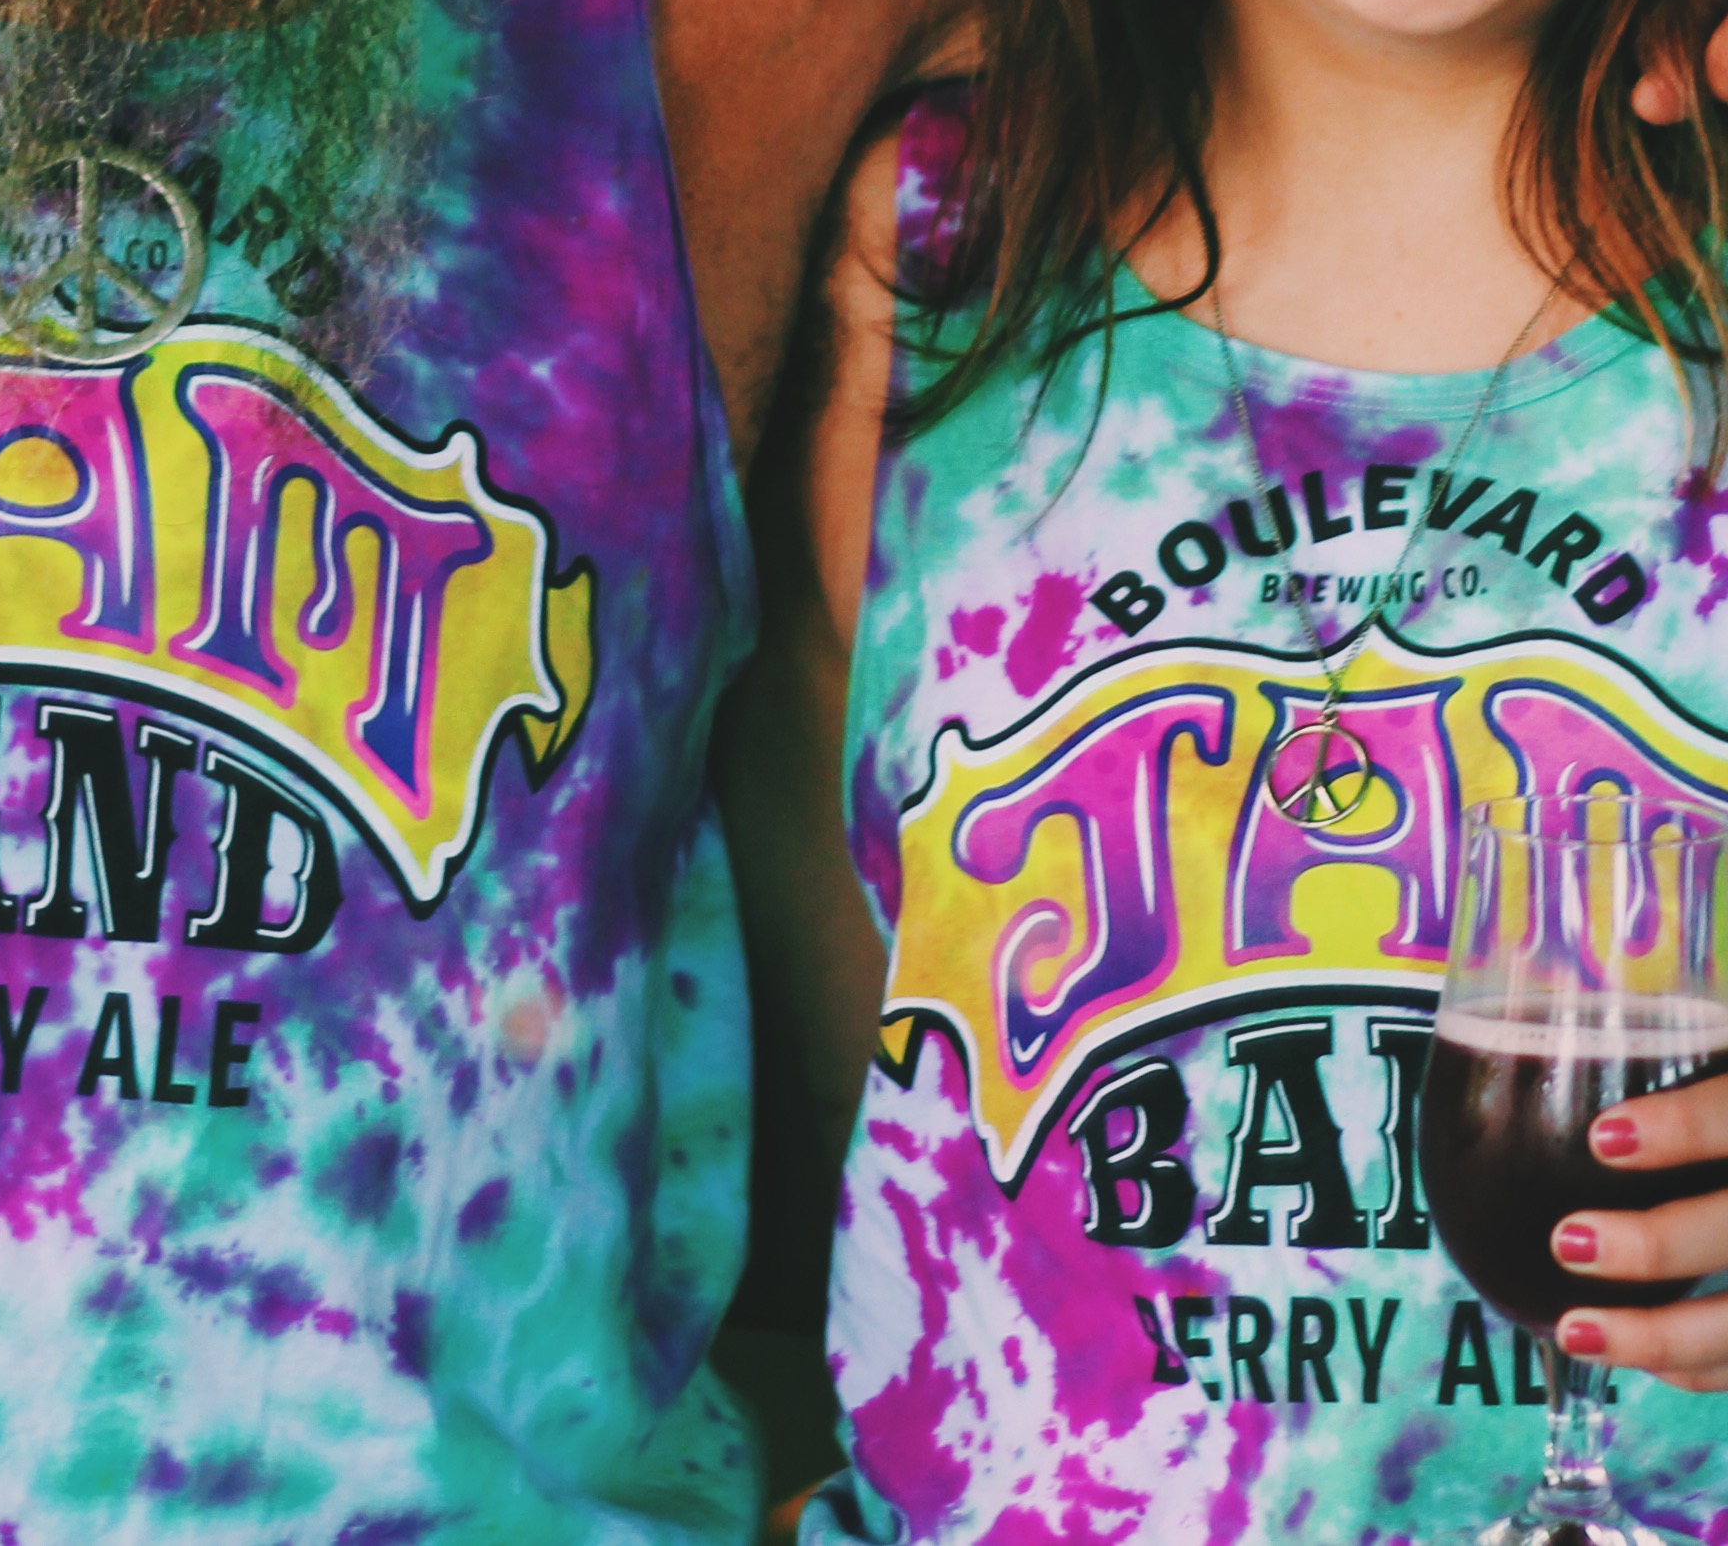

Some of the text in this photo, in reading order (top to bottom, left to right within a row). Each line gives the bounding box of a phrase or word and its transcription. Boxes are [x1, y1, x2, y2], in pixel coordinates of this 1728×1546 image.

[1088, 462, 1648, 638] BOULEVARD
[1441, 563, 1489, 599] CO.
[75, 990, 264, 1110] ALE
[1436, 1299, 1618, 1407] AL
